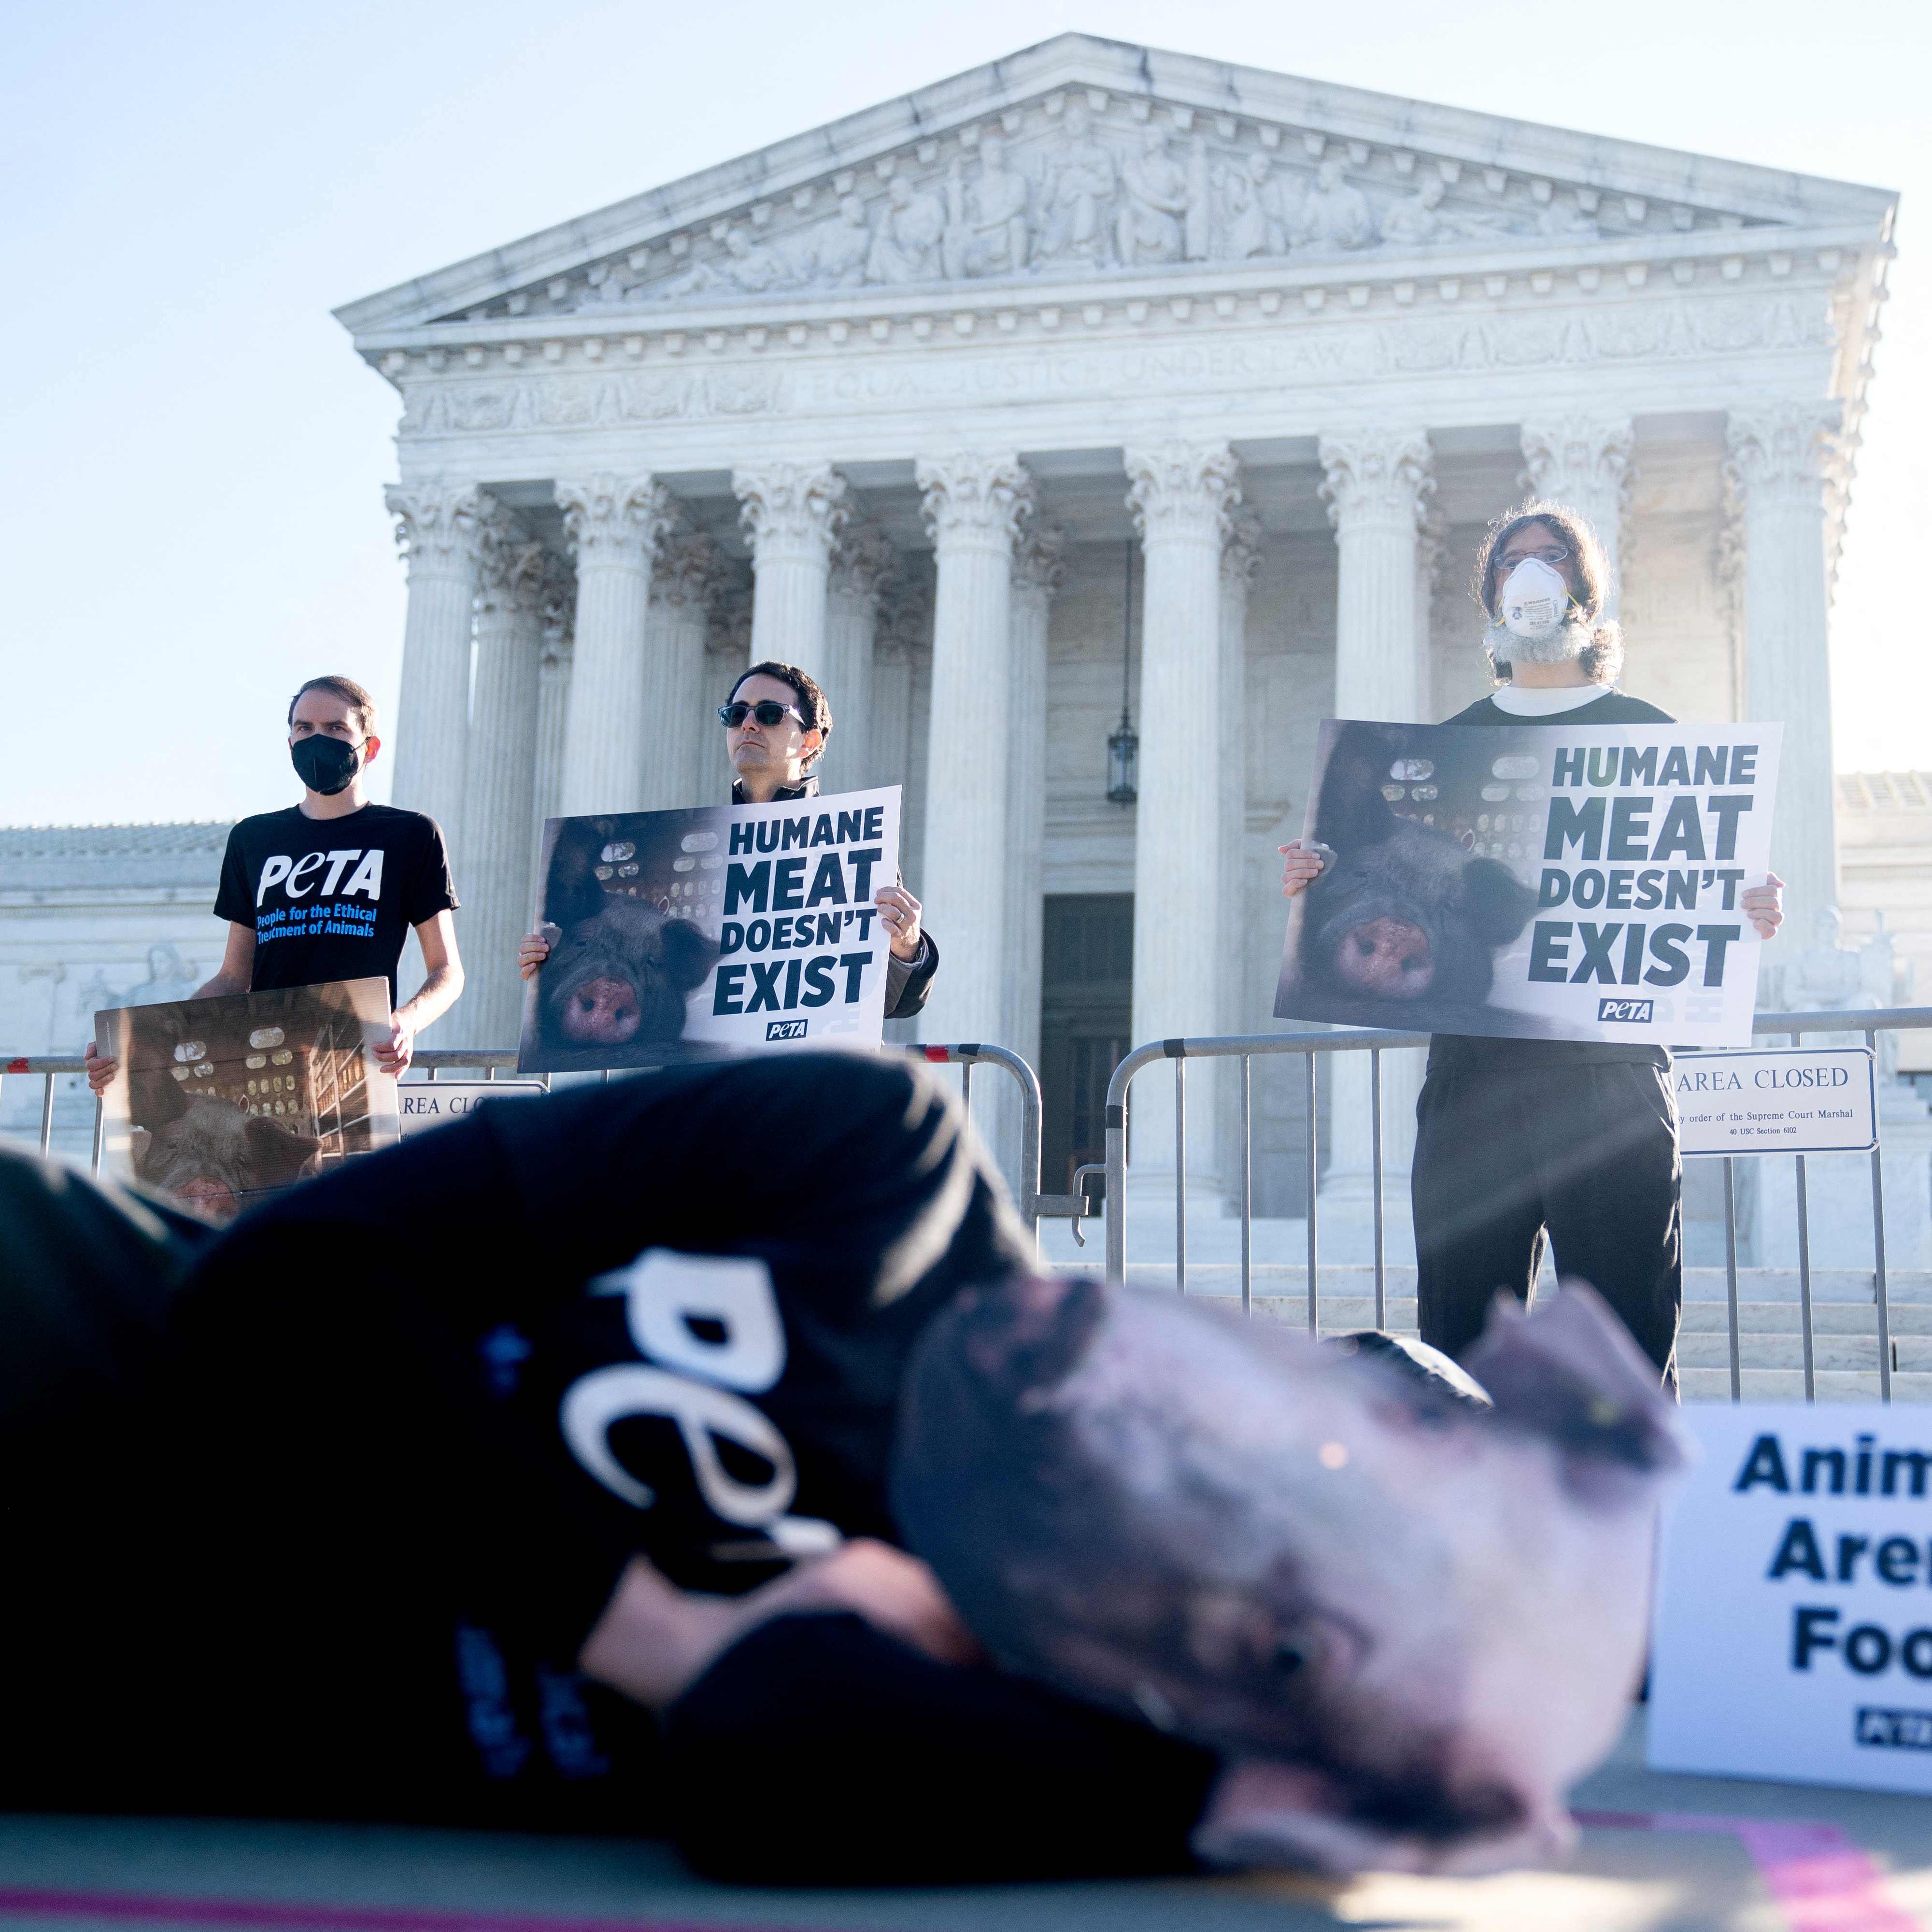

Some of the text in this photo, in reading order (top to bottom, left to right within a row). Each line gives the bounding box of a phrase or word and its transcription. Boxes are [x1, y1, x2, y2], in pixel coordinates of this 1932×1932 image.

[948, 353, 1100, 394] JUSTICE
[1122, 344, 1253, 381] UNDER
[1270, 338, 1349, 372] LAW
[1552, 745, 1759, 787] HUMANE
[729, 806, 884, 855] HUMANE
[1544, 795, 1754, 861] MEAT
[723, 848, 882, 916] MEAT
[1538, 868, 1745, 910] DOESN'T
[257, 904, 377, 929] People for the Ethical
[309, 921, 323, 934] of
[325, 920, 374, 937] Animals
[720, 909, 877, 954] DOESN'T
[1528, 921, 1741, 987] EXIST
[712, 951, 873, 1016] EXIST
[1677, 1067, 1848, 1092] AREA CLOSED
[400, 1097, 440, 1114] REA
[1678, 1116, 1685, 1124] y
[1716, 1113, 1725, 1121] of
[1730, 1112, 1743, 1121] the
[1747, 1111, 1784, 1122] Supreme
[1789, 1110, 1813, 1120] Court
[1818, 1109, 1853, 1119] Marshal
[1733, 1432, 1932, 1497] Anim
[1766, 1516, 1932, 1586] Are
[1790, 1606, 1932, 1678] Foo
